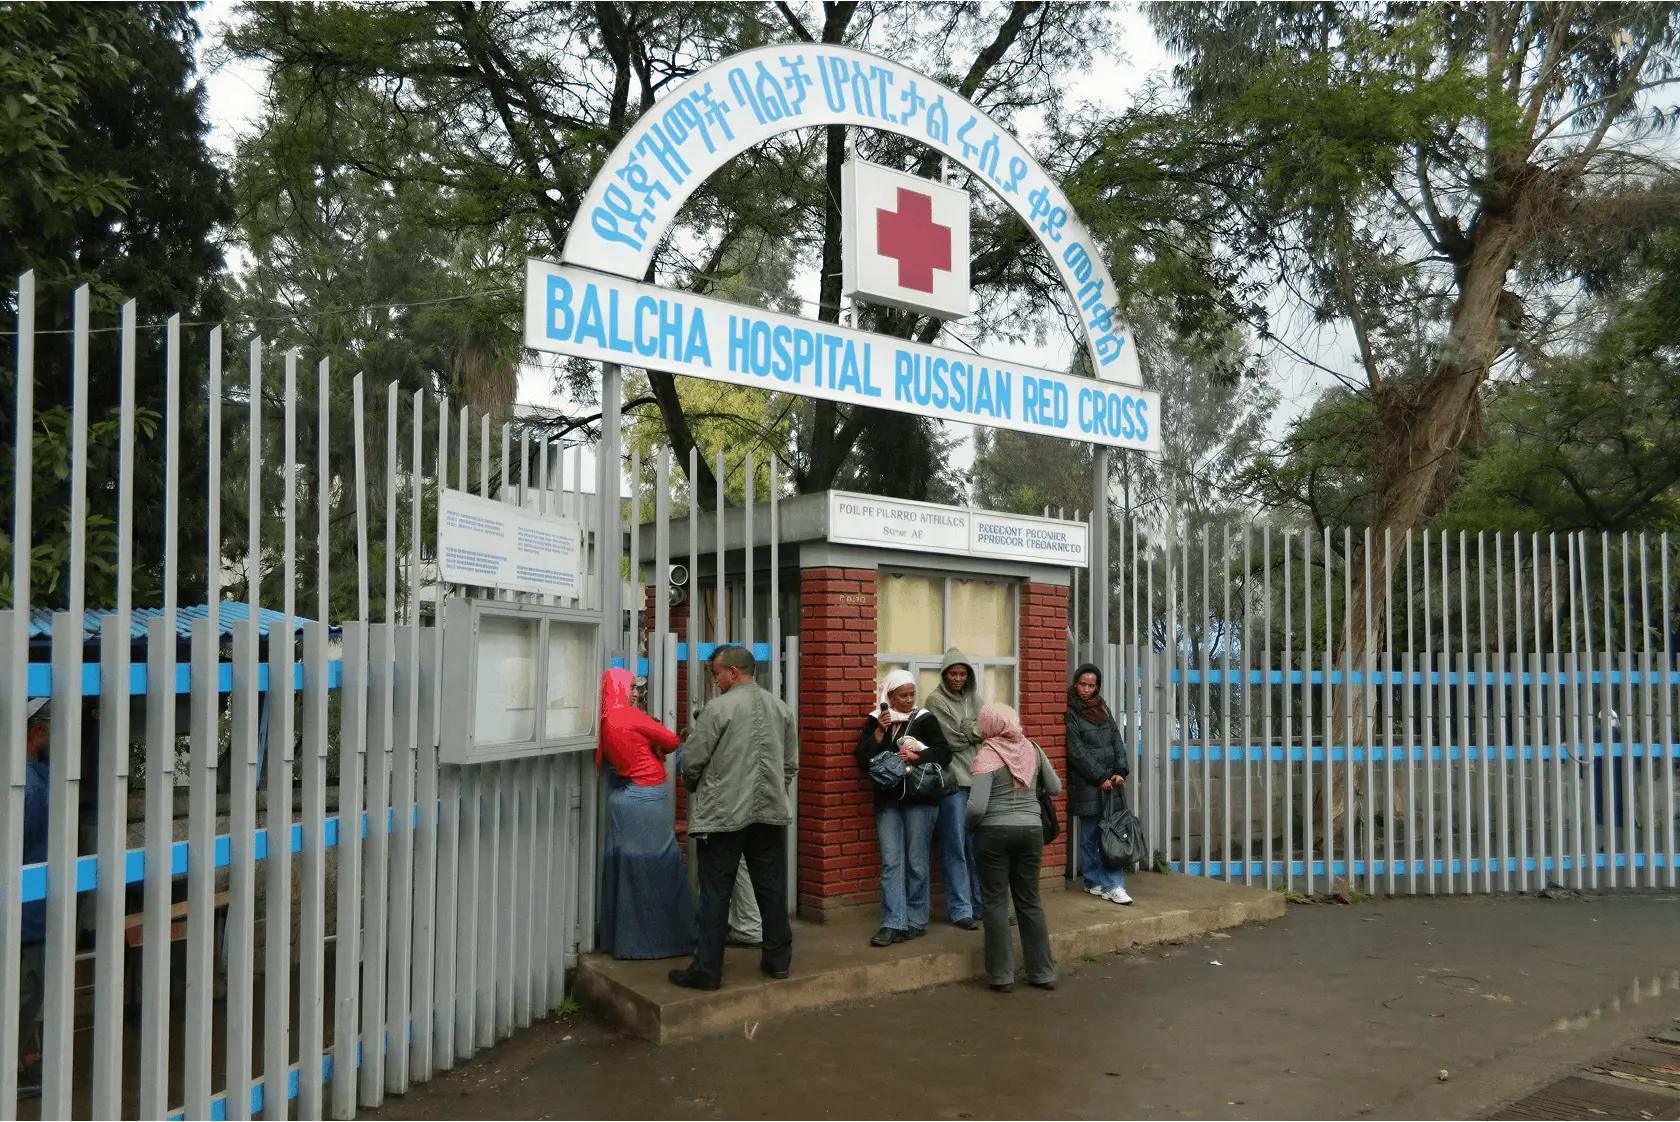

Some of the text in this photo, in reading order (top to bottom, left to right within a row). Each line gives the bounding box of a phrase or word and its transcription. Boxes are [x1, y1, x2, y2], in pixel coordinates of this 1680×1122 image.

[546, 274, 1149, 442] BALCHA HOSPITAL RUSSIAN RED CROSS
